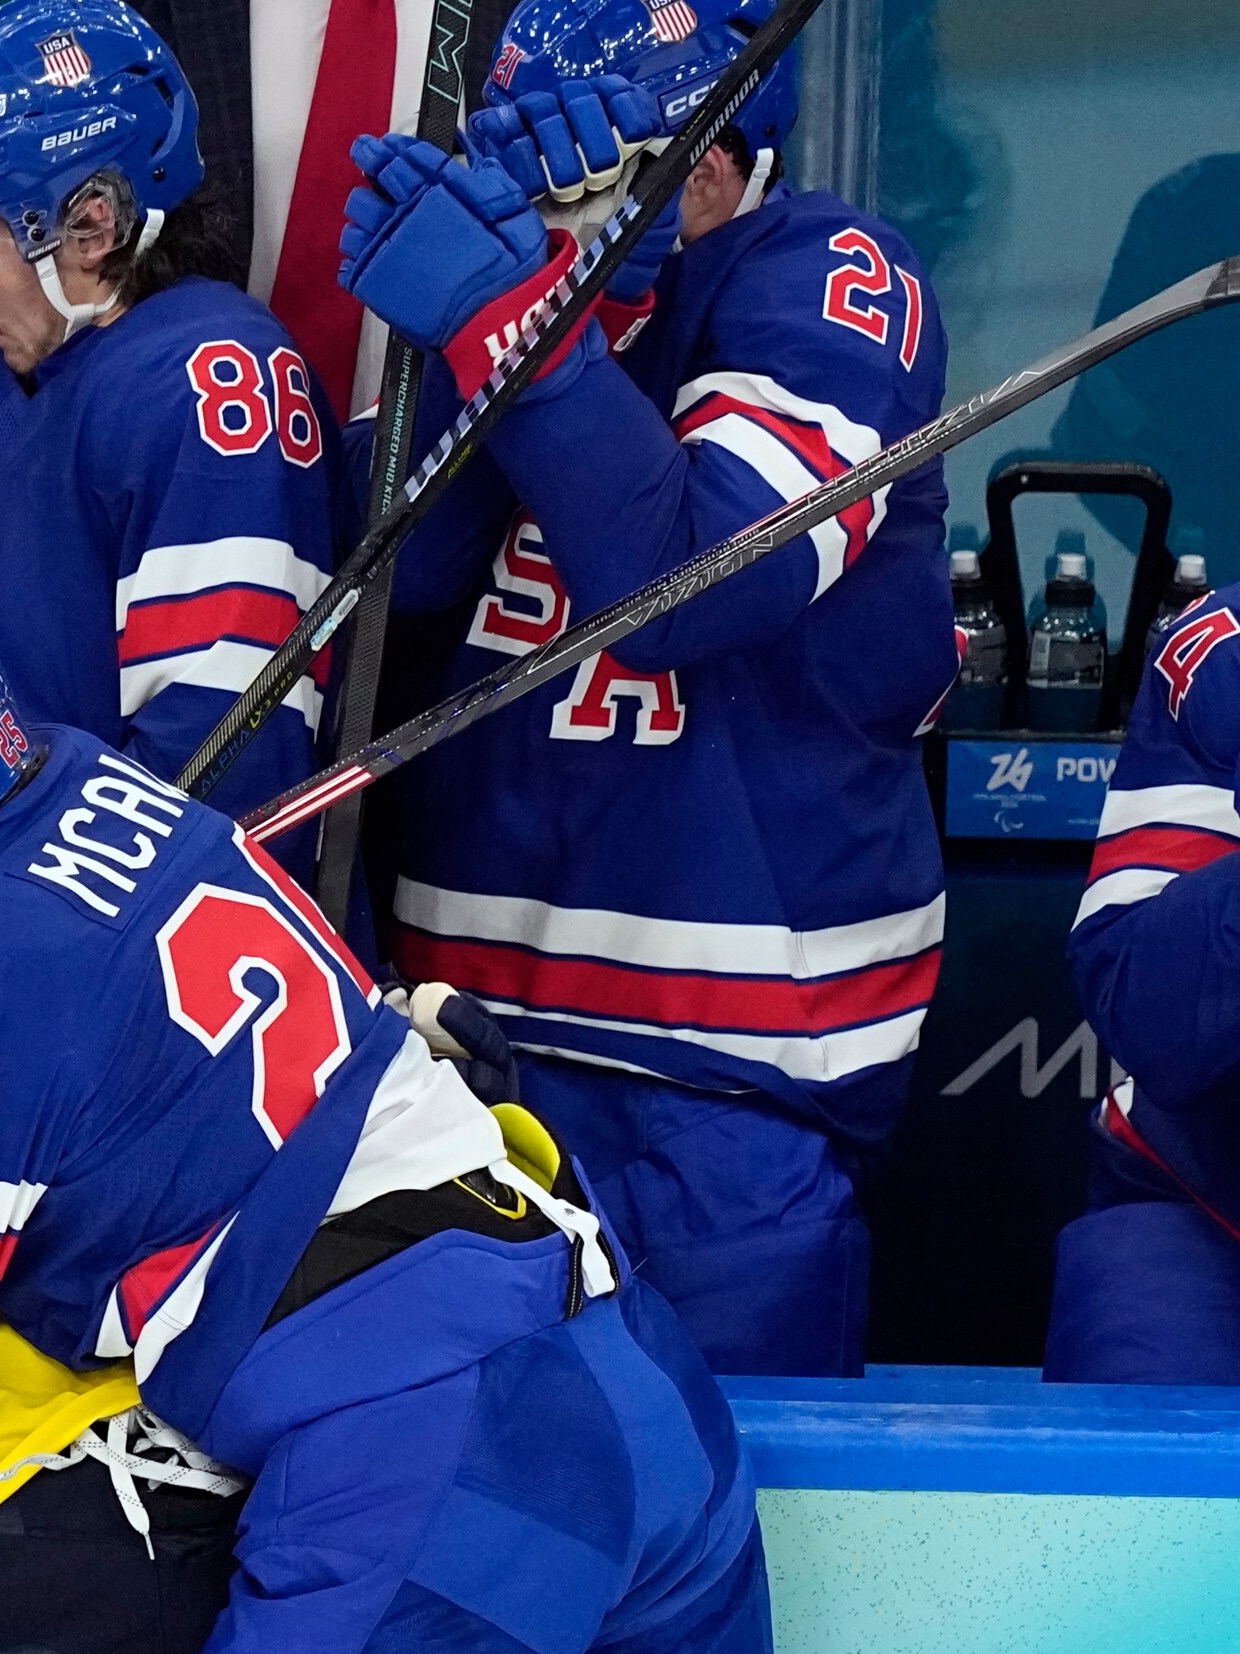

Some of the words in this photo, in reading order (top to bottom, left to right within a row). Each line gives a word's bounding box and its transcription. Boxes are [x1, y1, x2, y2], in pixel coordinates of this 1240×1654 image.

[43, 37, 72, 56] USA
[492, 43, 526, 90] 21
[666, 80, 719, 118] CC
[690, 69, 761, 166] WARRIOR
[41, 116, 118, 151] BAUER
[822, 227, 922, 372] 21
[404, 194, 642, 502] WARRIOR
[187, 340, 322, 468] 86
[390, 347, 413, 452] SUPERCHARGED
[385, 454, 398, 484] MID
[201, 729, 251, 793] ALPHA
